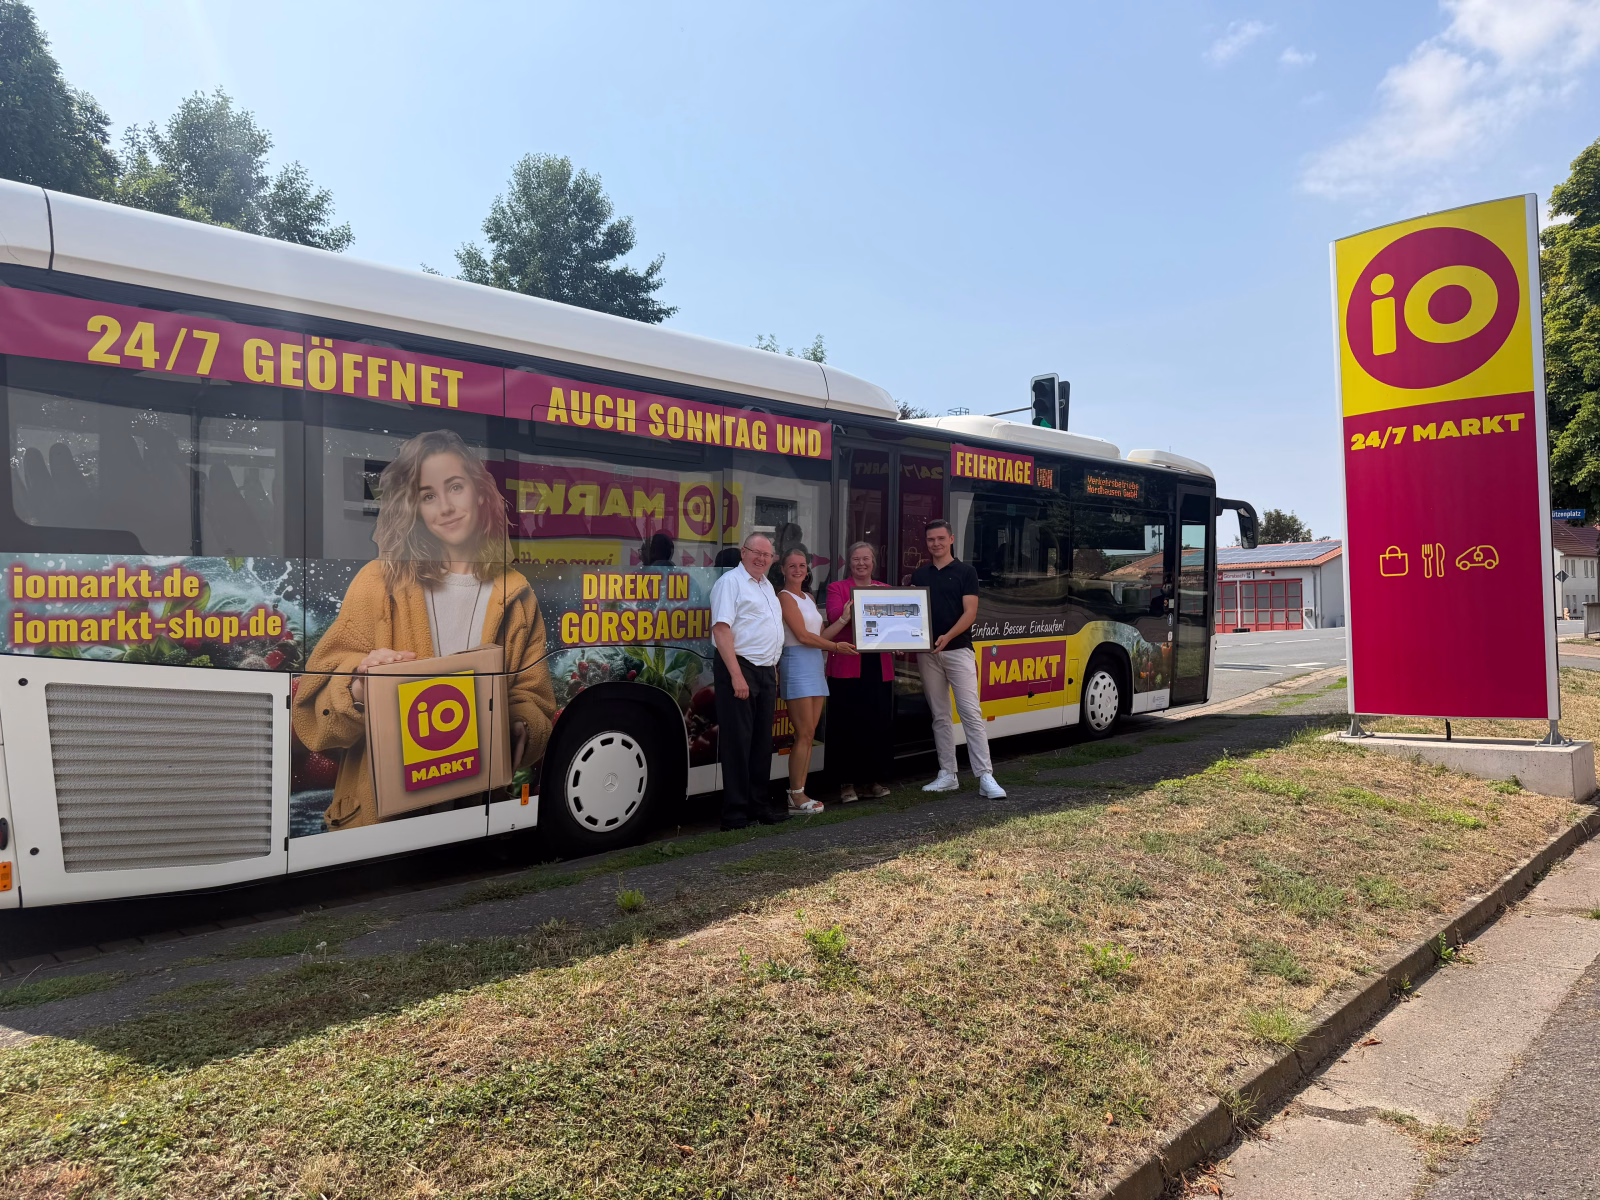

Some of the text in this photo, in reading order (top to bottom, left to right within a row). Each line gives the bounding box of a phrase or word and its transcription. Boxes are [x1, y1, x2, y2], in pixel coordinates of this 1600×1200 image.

[86, 314, 464, 408] 24/7 GEÖFFNET
[546, 387, 822, 457] AUCH SONNTAG UND
[1350, 413, 1525, 451] 24/7 MARKT
[956, 451, 1032, 485] FEIERTAGE
[1552, 510, 1581, 518] ützenplatz
[13, 567, 200, 598] iomarkt.de
[582, 573, 688, 600] DIREKT IN
[13, 608, 282, 644] iomarkt-shop.de
[561, 604, 711, 644] GÖRSBACH!
[971, 619, 1066, 638] Einfach. Besser. Einkaufen!
[989, 655, 1061, 686] MARKT
[411, 756, 475, 783] MARKT
